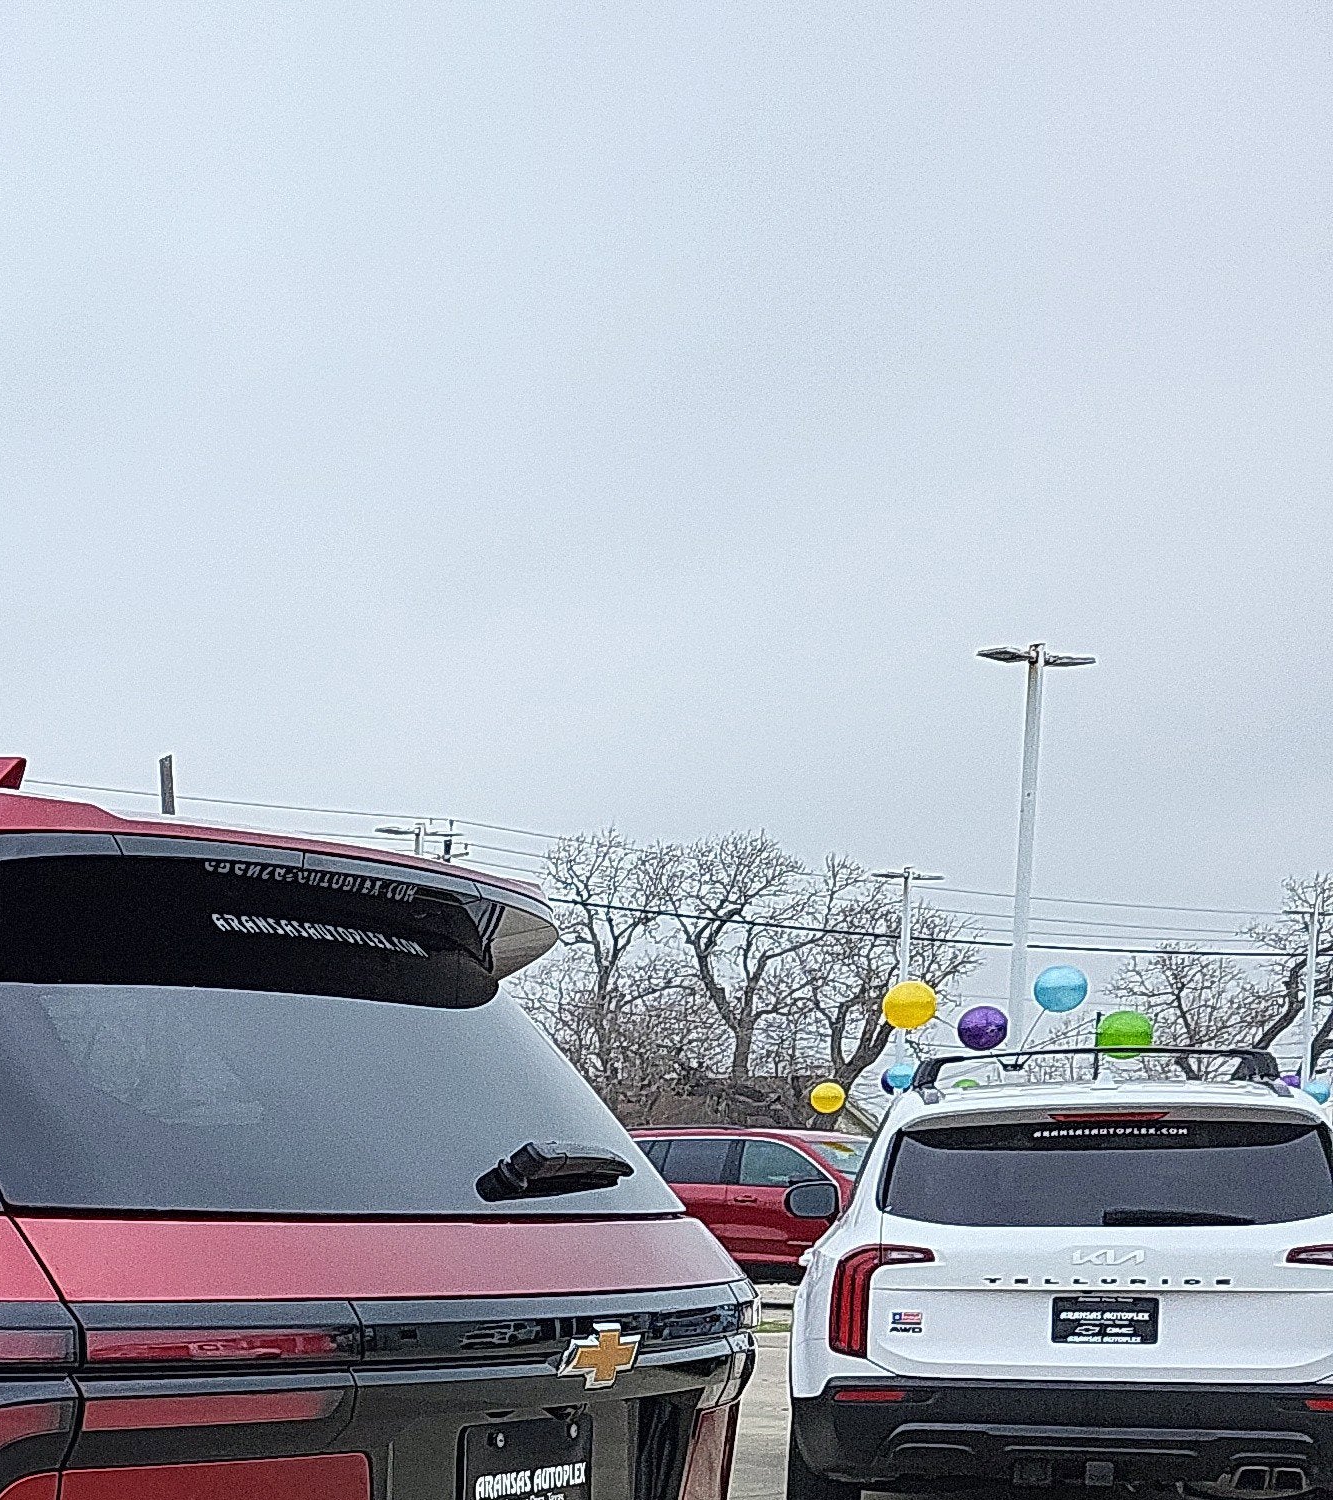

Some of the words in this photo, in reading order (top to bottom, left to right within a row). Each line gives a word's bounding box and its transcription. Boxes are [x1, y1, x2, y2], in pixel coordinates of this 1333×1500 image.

[211, 913, 429, 958] ARANSASAUTOPLEX.COM
[983, 1277, 1232, 1286] TELLURIDE
[889, 1326, 923, 1334] AWD
[475, 1469, 532, 1500] ARANSAS
[533, 1461, 587, 1493] AUTOPLEX
